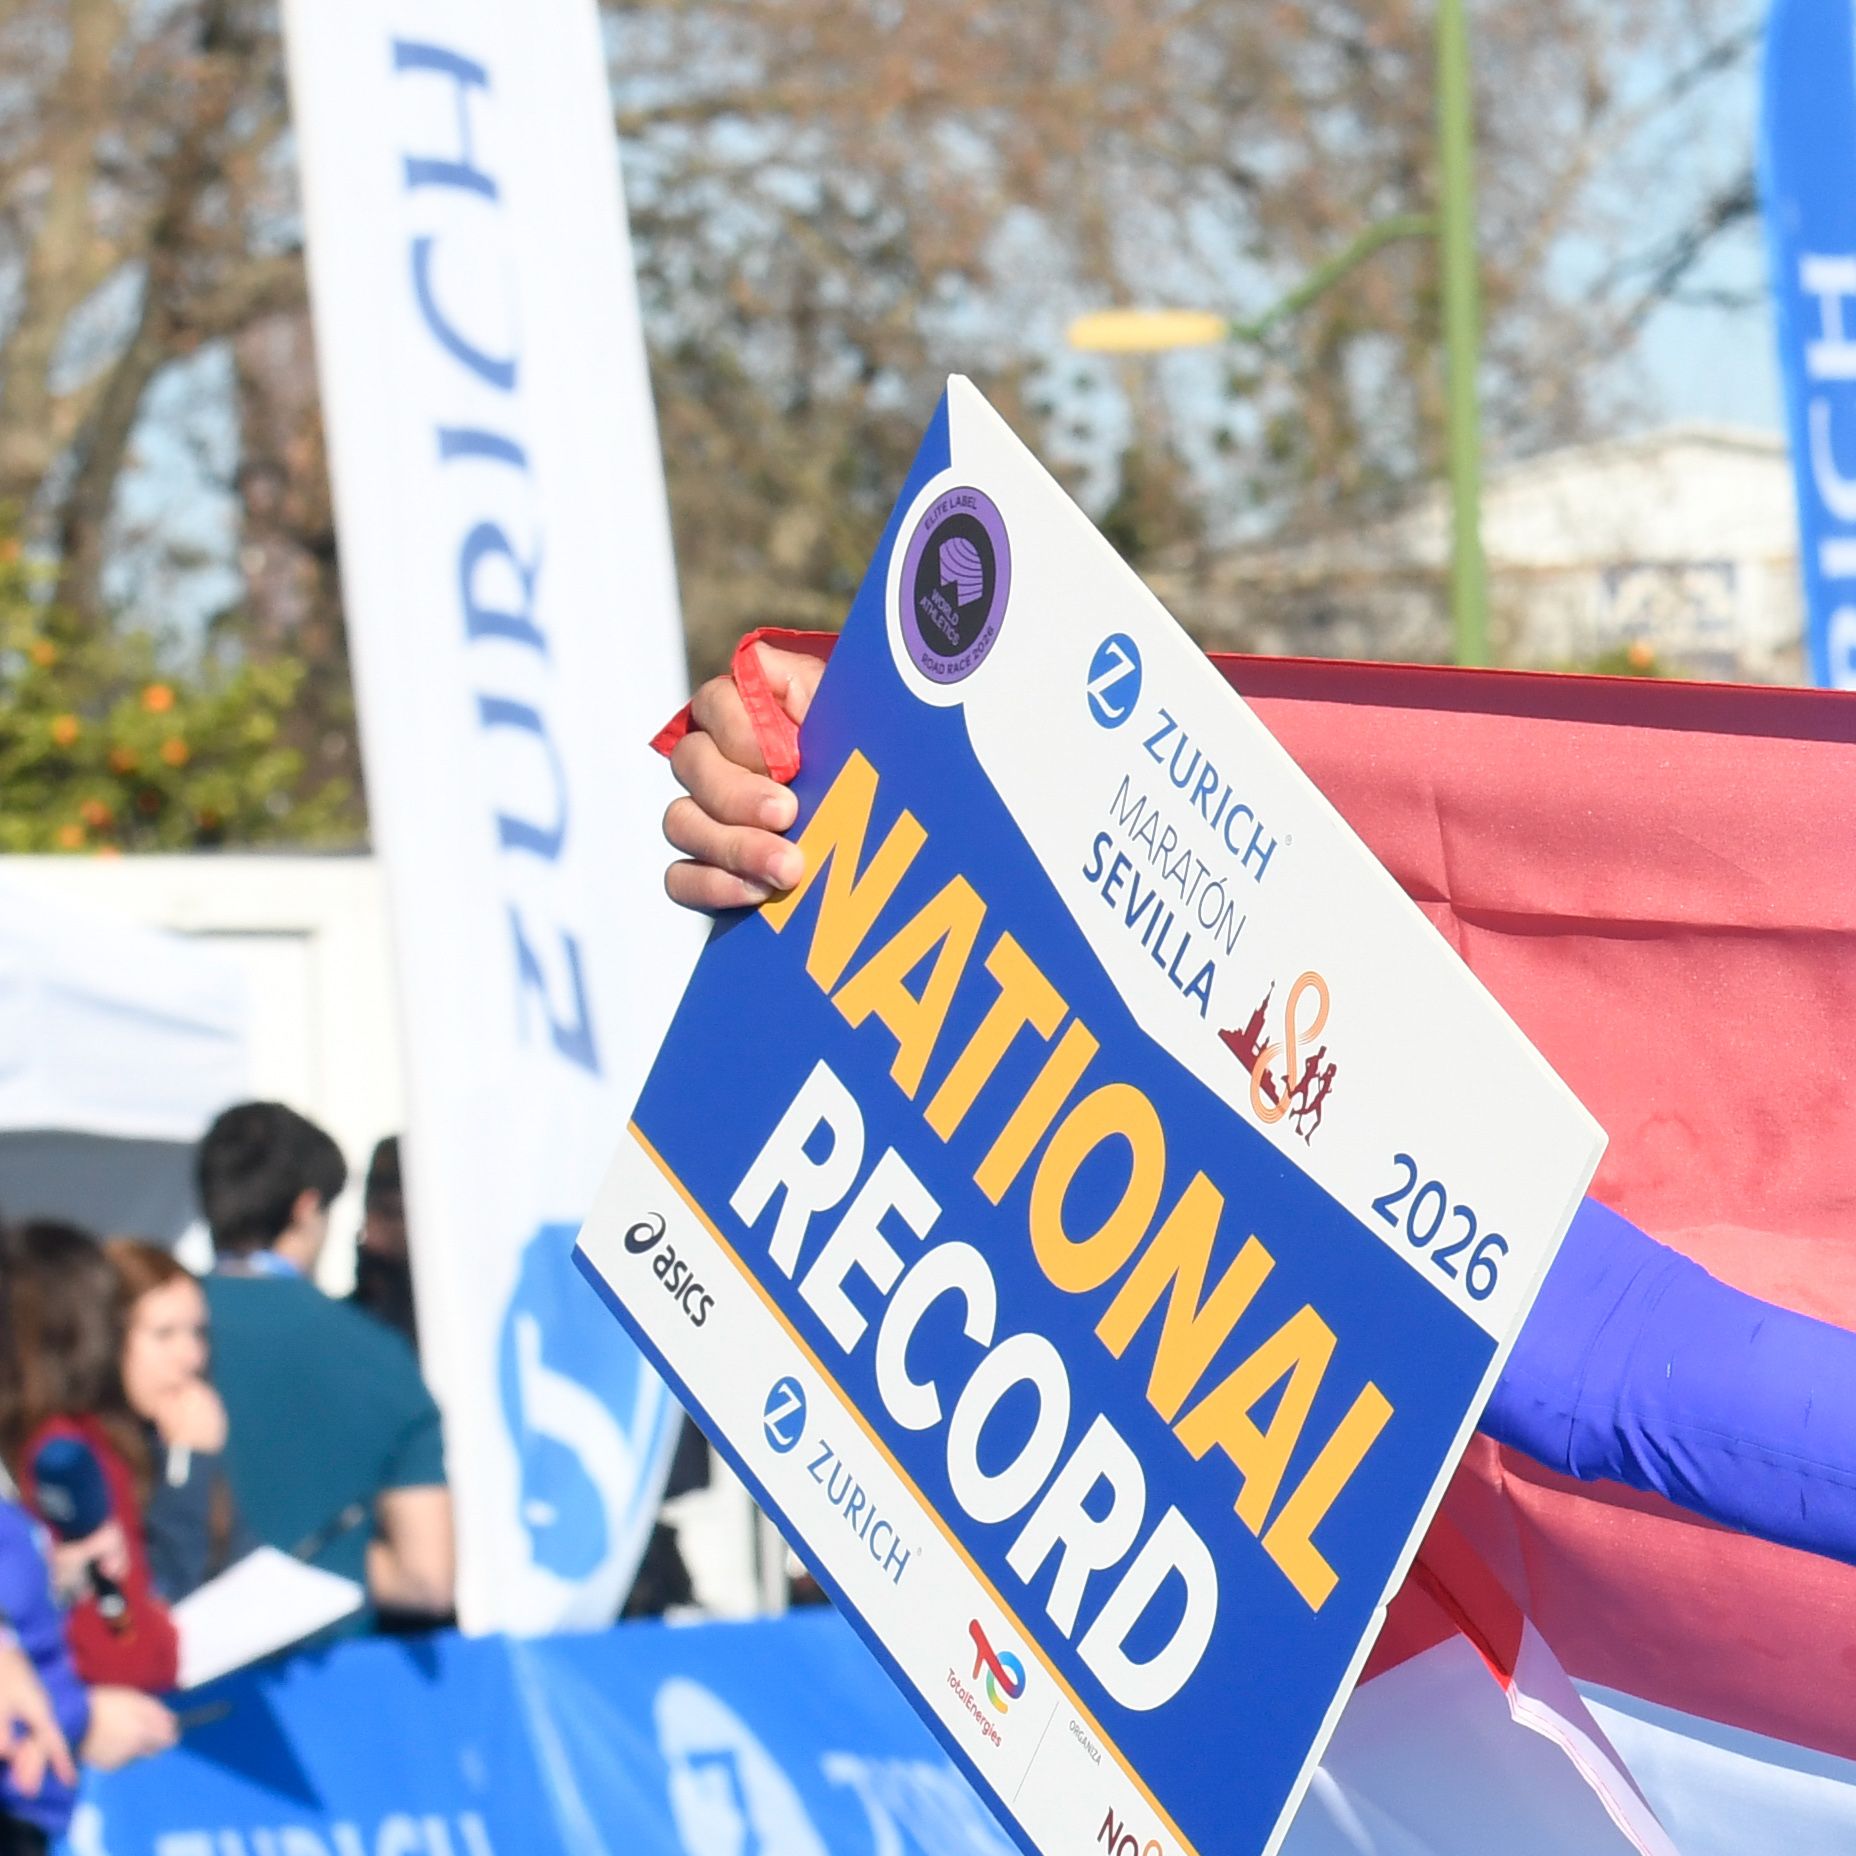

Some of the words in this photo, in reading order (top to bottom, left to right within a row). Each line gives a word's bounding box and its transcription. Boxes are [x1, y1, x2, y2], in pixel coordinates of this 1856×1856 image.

[388, 34, 608, 1082] ZURICH
[924, 500, 949, 530] ELITE
[949, 496, 978, 511] LABEL
[919, 596, 960, 647] ATHLETICS
[920, 652, 946, 676] ROAD
[946, 654, 973, 675] RACE
[972, 625, 995, 659] 2026
[931, 588, 960, 627] WORLD
[1108, 773, 1247, 956] MARATÓN
[1141, 707, 1278, 884] ZURICH
[1081, 830, 1217, 1020] SEVILLA
[757, 747, 1396, 1613] NATIONAL
[1370, 1152, 1510, 1302] 2026
[729, 1058, 1220, 1712] RECORD
[806, 1438, 911, 1586] ZURICH
[948, 1667, 1003, 1748] TotalEnergies
[1067, 1718, 1103, 1767] ORGANIZA
